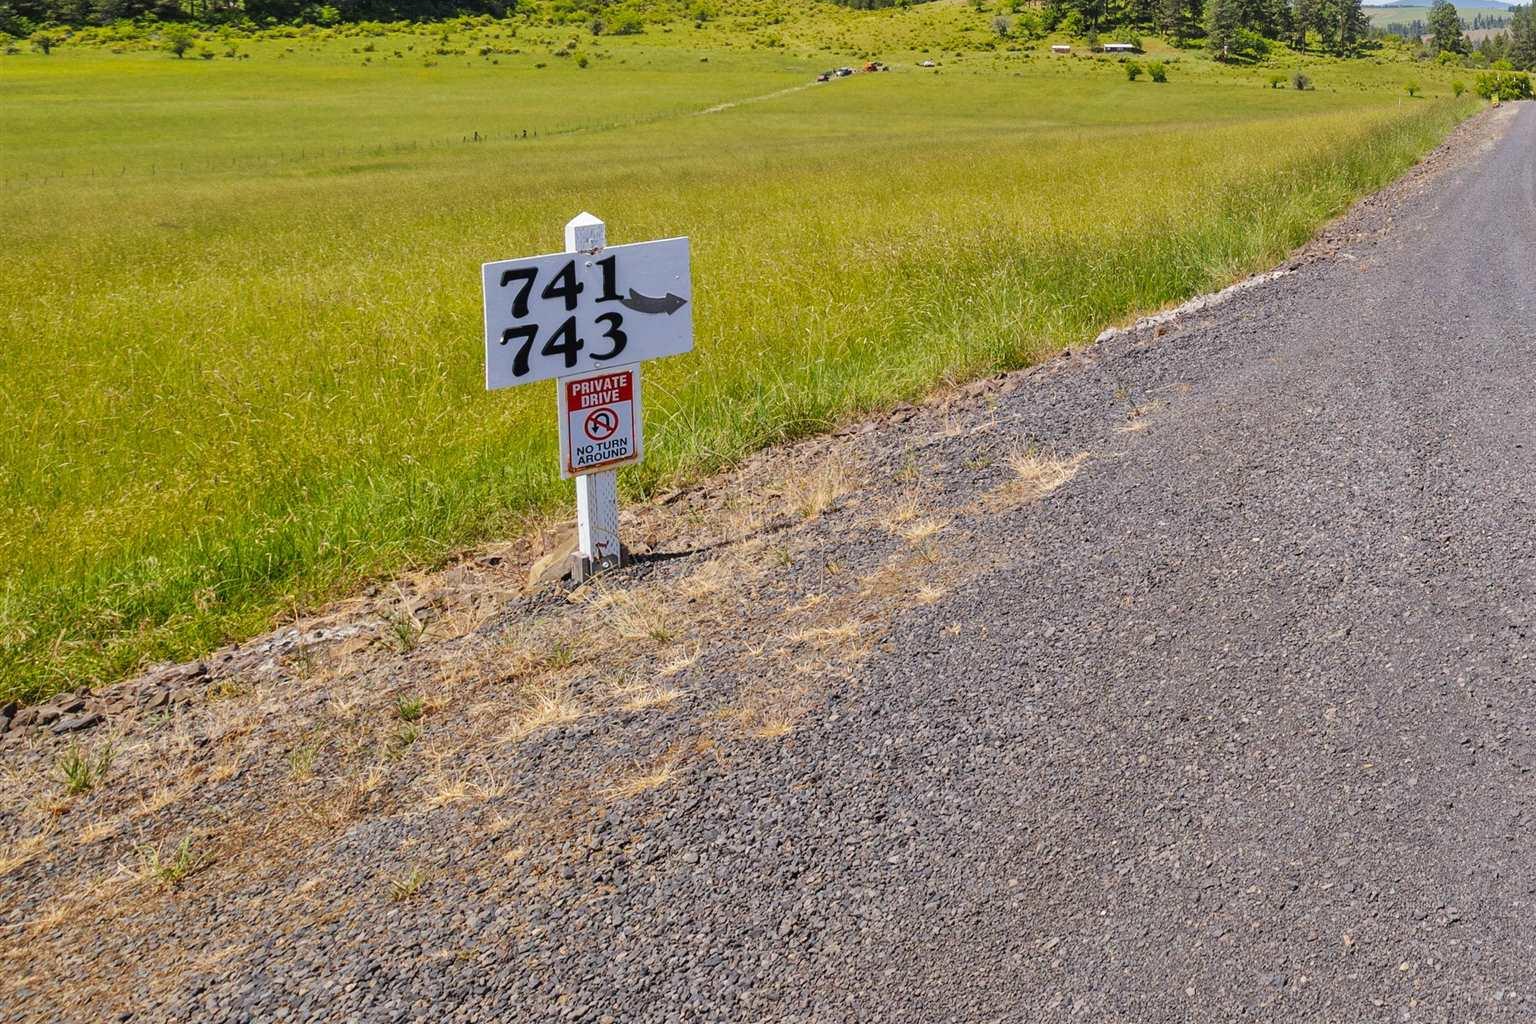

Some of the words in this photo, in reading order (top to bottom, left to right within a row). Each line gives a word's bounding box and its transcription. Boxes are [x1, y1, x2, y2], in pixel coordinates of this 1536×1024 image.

[500, 254, 624, 318] 741
[500, 312, 627, 377] 743
[572, 374, 628, 396] PRIVATE
[581, 389, 620, 408] DRIVE
[576, 444, 594, 456] NO
[597, 437, 628, 451] TURN
[577, 447, 628, 465] AROUND
